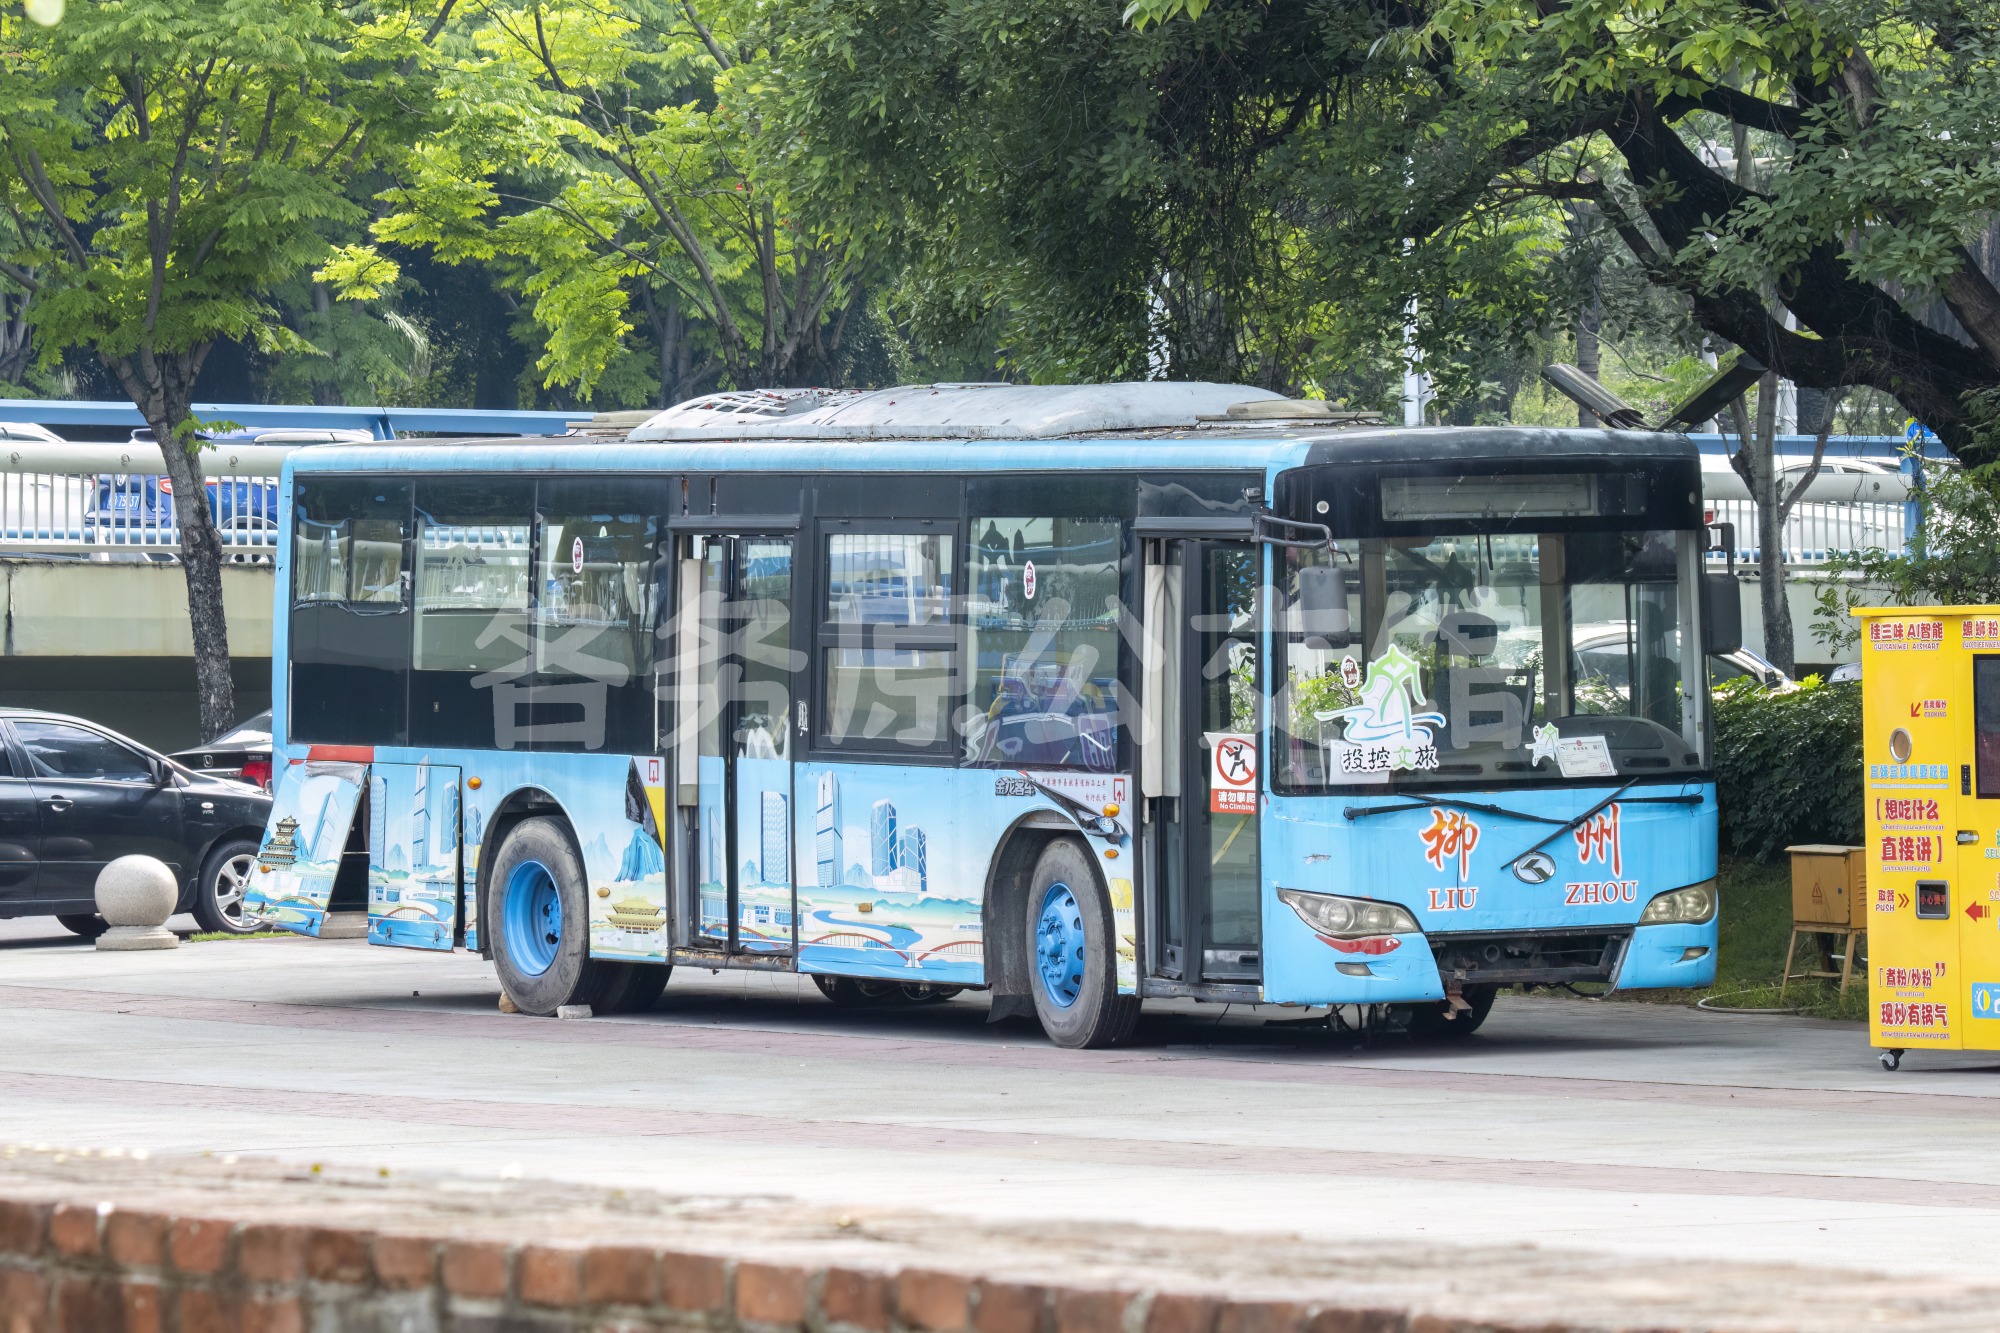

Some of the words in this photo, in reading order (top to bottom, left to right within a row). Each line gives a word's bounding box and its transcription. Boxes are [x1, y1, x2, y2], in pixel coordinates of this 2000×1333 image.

[1870, 623, 1903, 640] 桂三味
[1907, 622, 1943, 639] AI智能
[1342, 745, 1437, 771] 投控文旅
[1217, 791, 1256, 804] 请勿攀爬
[1229, 803, 1255, 812] Climbing
[1419, 807, 1480, 881] 柳
[1573, 802, 1622, 877] 州
[1428, 888, 1478, 910] LIU
[1565, 881, 1638, 904] ZHOU
[1878, 889, 1895, 902] 取餐
[1876, 903, 1895, 912] PUSH
[1881, 1003, 1948, 1027] 现炒有锅气
